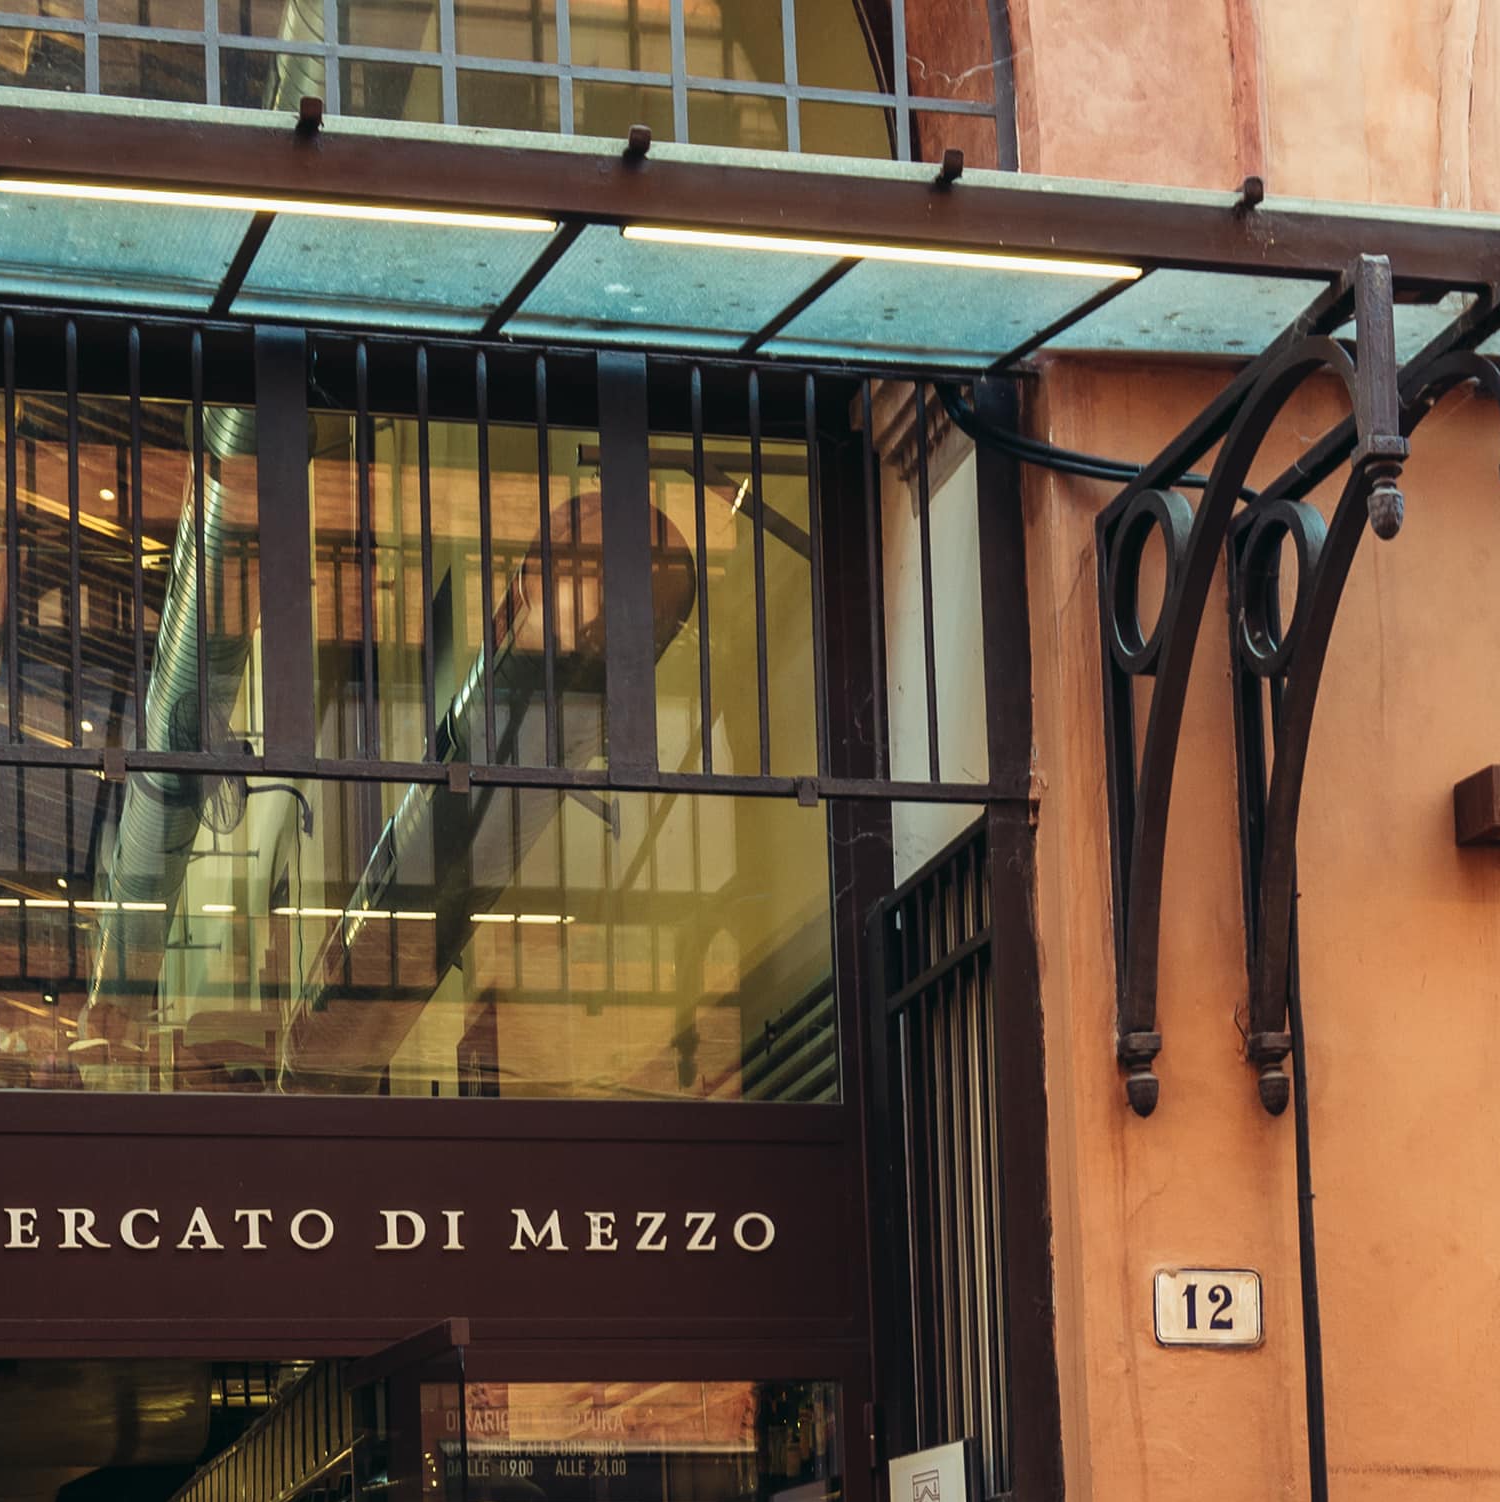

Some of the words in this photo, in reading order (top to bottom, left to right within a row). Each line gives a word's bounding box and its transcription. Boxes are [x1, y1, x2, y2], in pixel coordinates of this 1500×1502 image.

[374, 1208, 464, 1251] DI
[509, 1208, 776, 1253] MEZZO
[1182, 1283, 1233, 1330] 12
[556, 1460, 586, 1476] ALLE
[594, 1459, 627, 1476] 24.00
